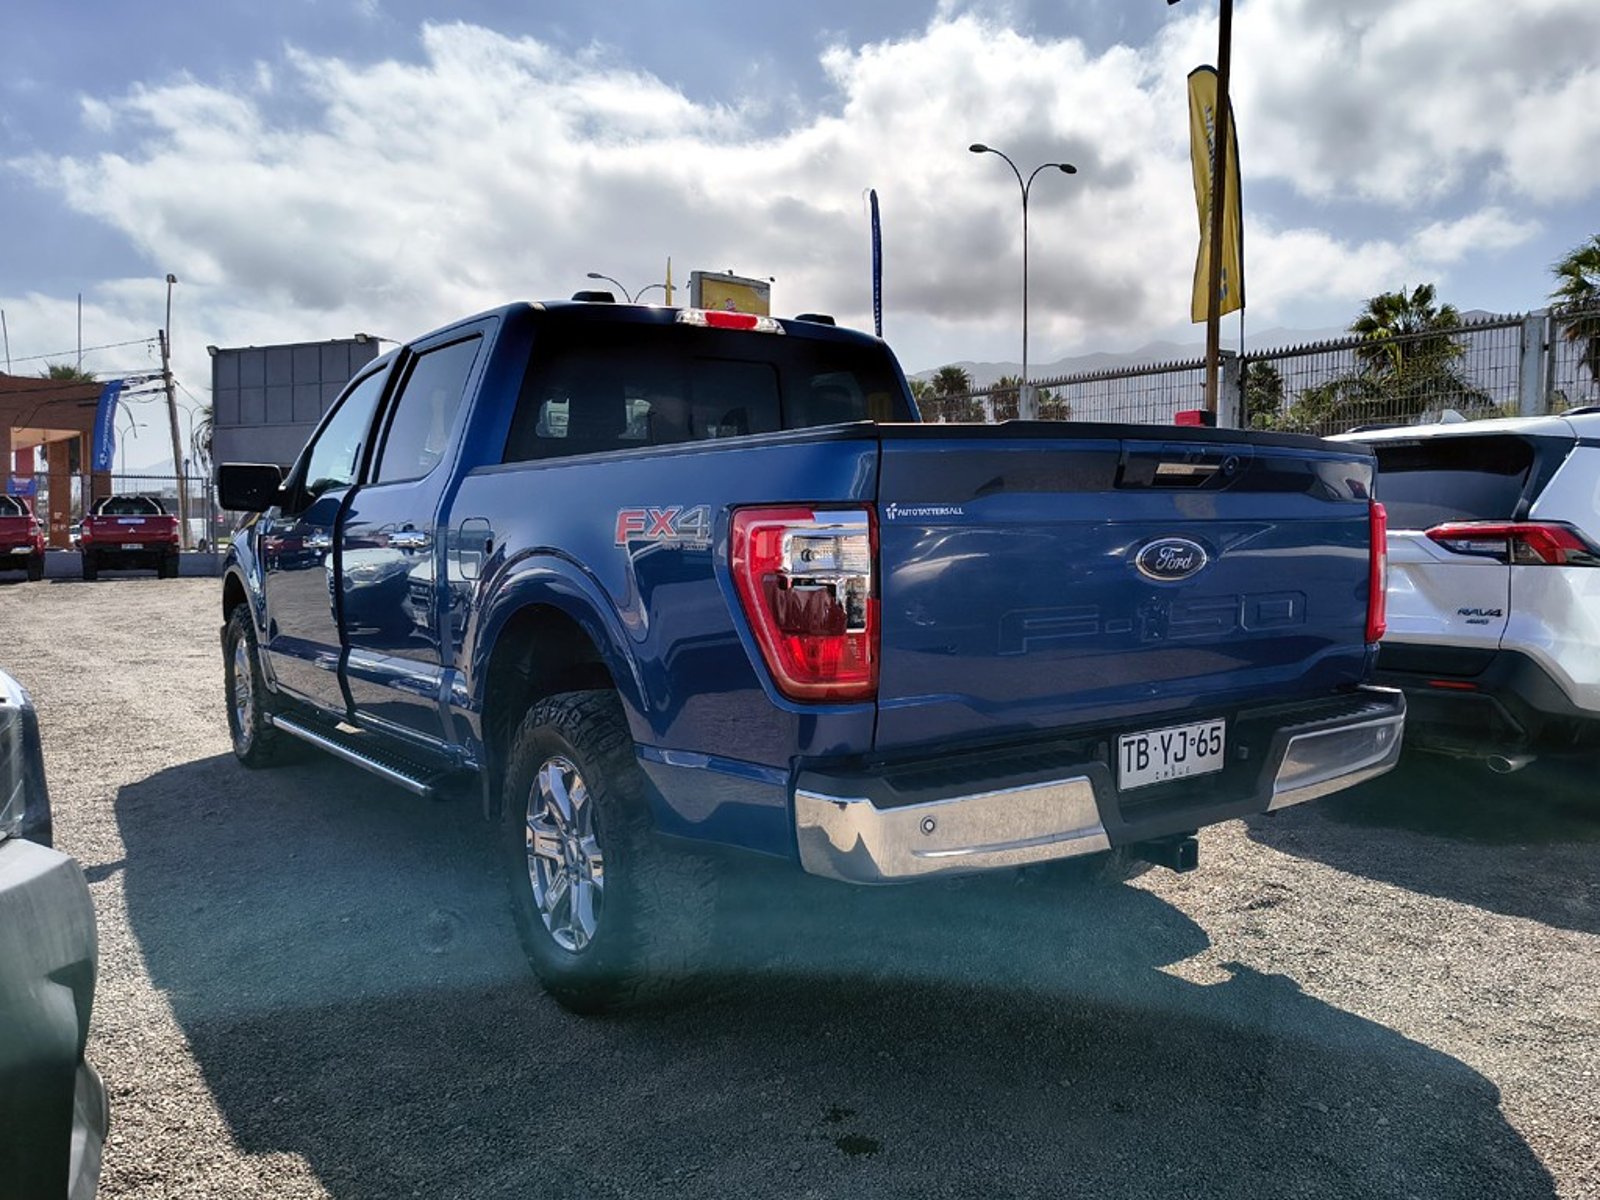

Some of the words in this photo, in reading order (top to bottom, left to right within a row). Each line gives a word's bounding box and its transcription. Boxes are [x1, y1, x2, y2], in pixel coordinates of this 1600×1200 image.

[897, 506, 964, 516] AUTOTATTERSALL
[614, 505, 712, 547] FX4
[1155, 546, 1193, 570] Ford
[998, 590, 1307, 655] F-150
[1457, 608, 1503, 617] RAV4
